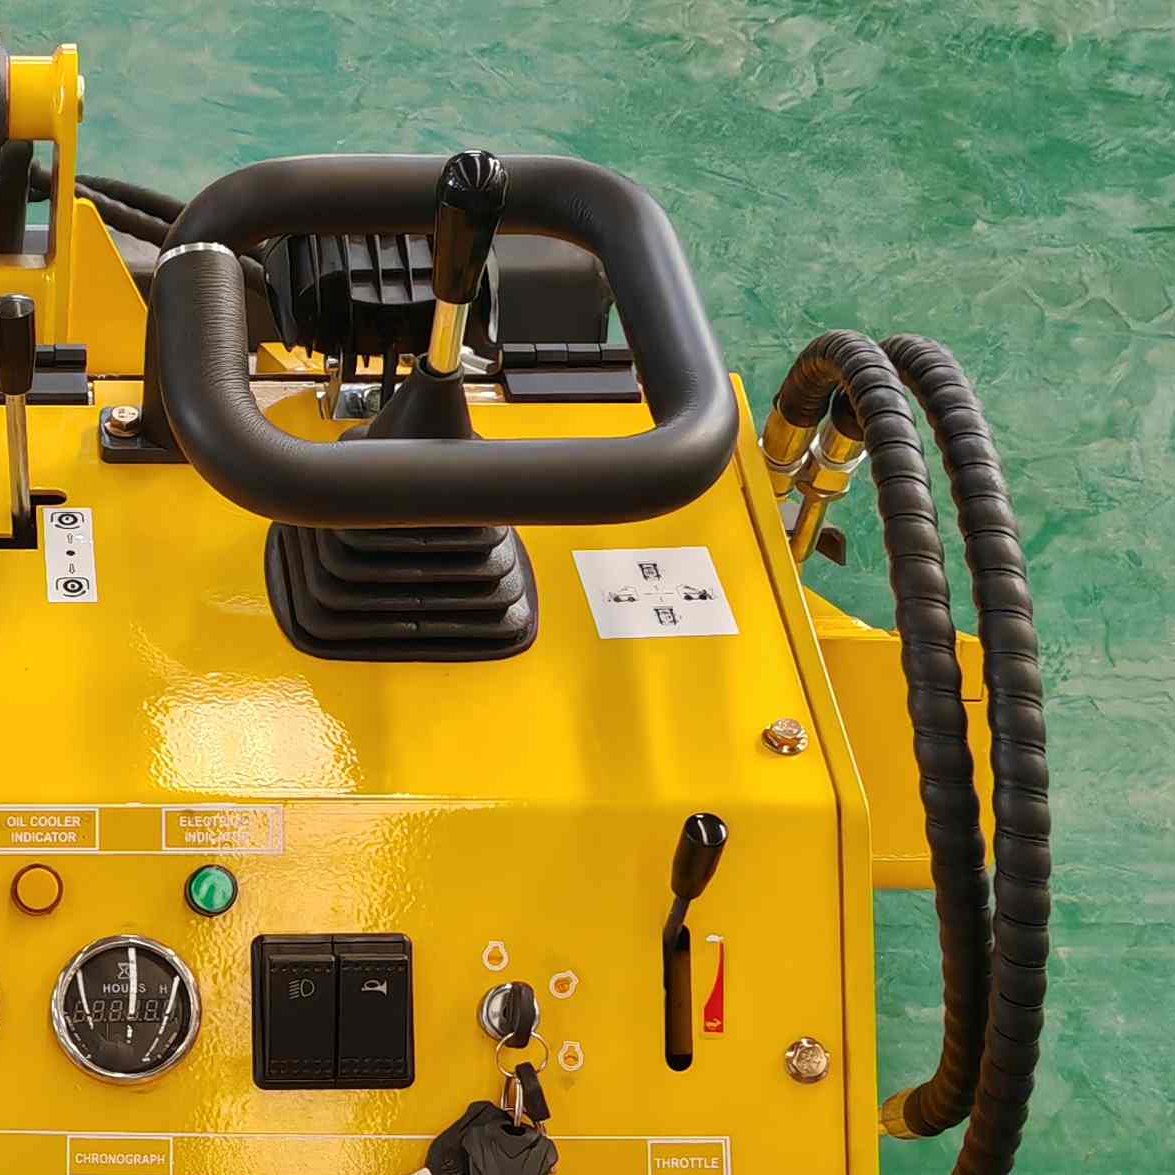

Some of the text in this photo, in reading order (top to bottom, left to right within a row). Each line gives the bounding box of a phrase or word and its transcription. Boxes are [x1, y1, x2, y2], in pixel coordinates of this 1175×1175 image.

[7, 815, 82, 828] OIL COOLER
[10, 831, 78, 843] INDICATOR
[185, 831, 250, 843] INDIC
[103, 983, 146, 994] HOUS
[75, 1153, 165, 1165] CHRONOGRAPH
[654, 1157, 720, 1169] THROTTLE
